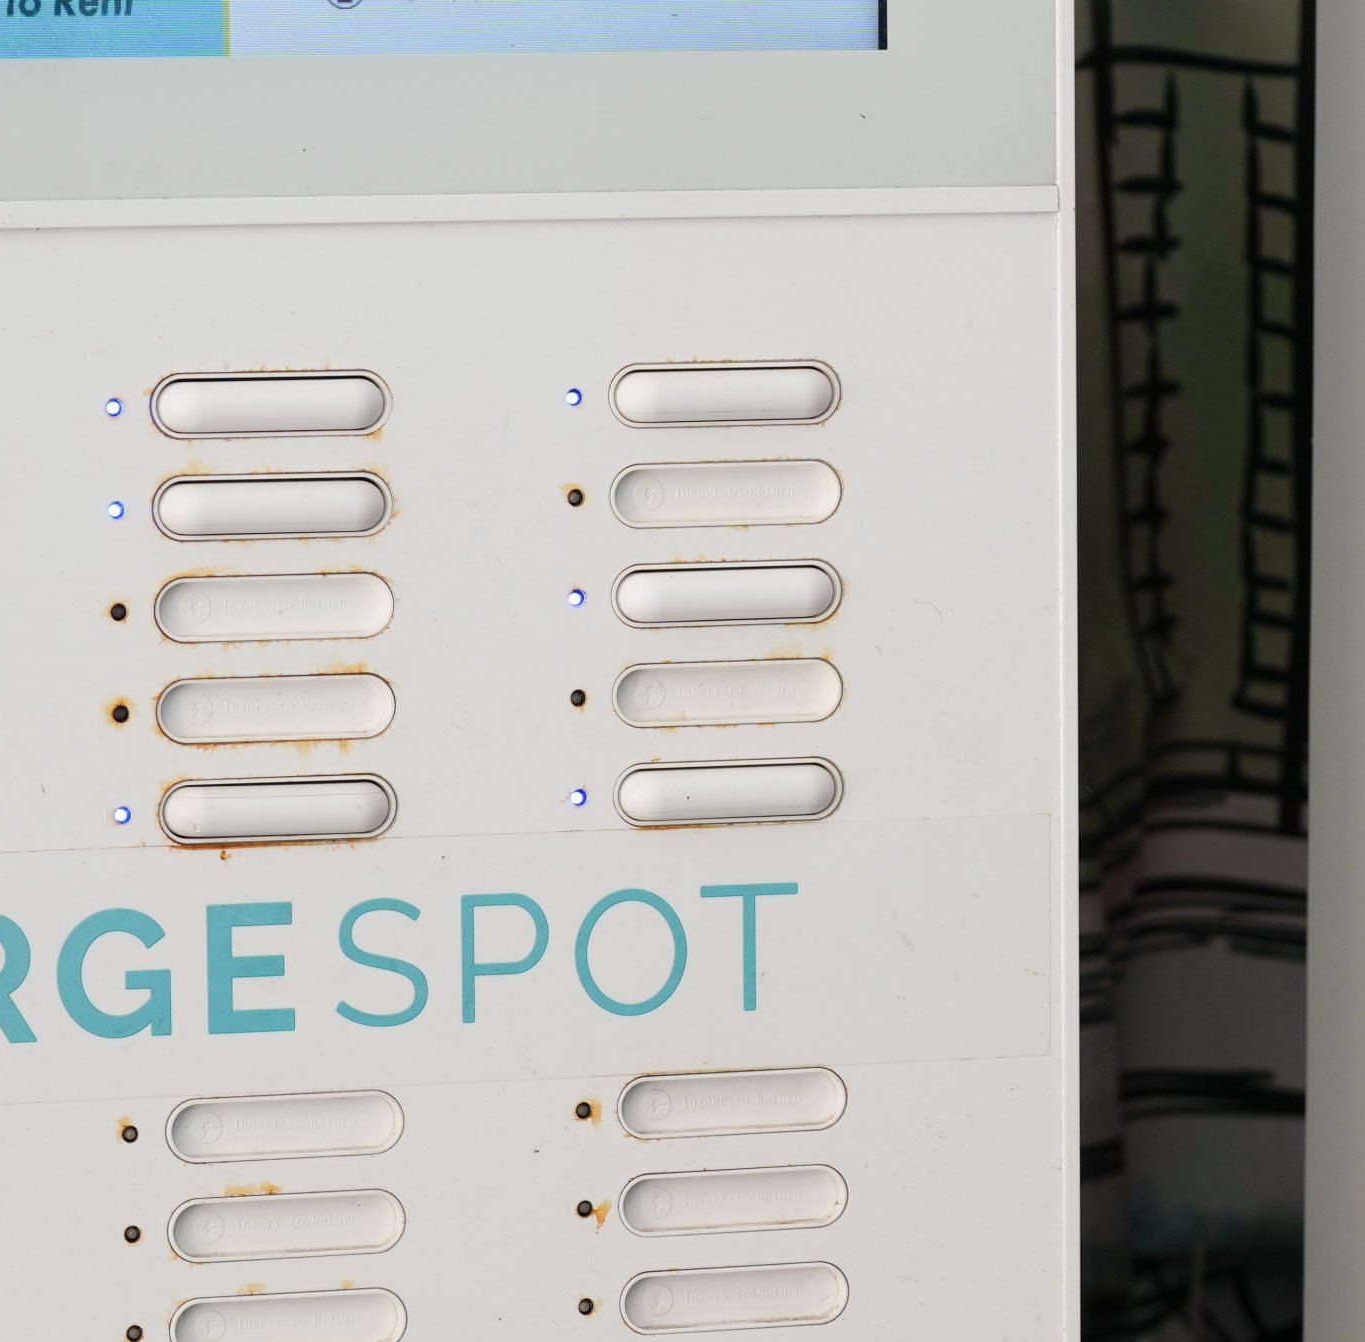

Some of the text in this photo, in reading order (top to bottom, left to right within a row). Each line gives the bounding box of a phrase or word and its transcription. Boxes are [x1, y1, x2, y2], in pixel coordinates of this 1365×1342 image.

[749, 484, 795, 496] Return
[299, 597, 348, 610] Return
[749, 682, 795, 695] Return
[301, 698, 348, 711] Return
[755, 1092, 801, 1104] Return
[309, 1115, 356, 1128] Return
[757, 1189, 801, 1200] Return
[311, 1215, 359, 1227] Return
[757, 1287, 802, 1298] Return
[313, 1313, 359, 1326] Return
